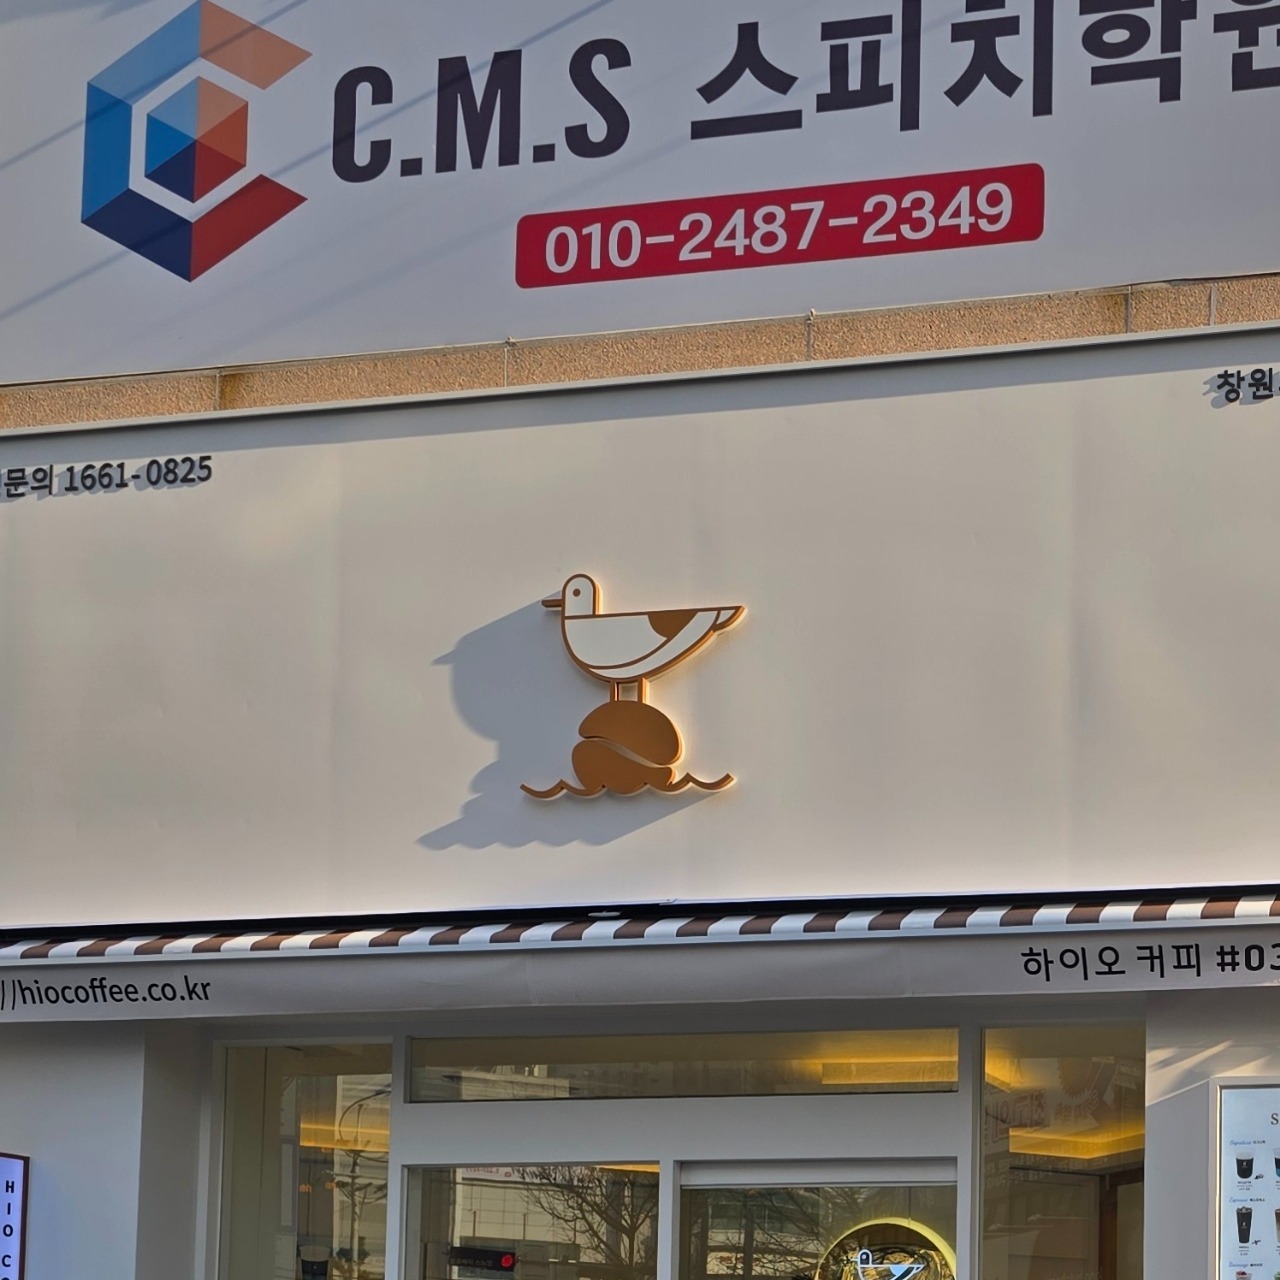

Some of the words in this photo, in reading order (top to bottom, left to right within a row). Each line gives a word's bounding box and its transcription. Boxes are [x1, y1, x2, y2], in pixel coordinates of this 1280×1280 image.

[331, 38, 631, 184] C.M.S
[544, 182, 1013, 274] 010-2487-2349
[4, 464, 54, 497] 문의
[64, 455, 212, 492] 1661-0825
[1021, 946, 1126, 982] 하이오
[1136, 942, 1202, 979] 커피
[3, 1180, 14, 1237] HIO
